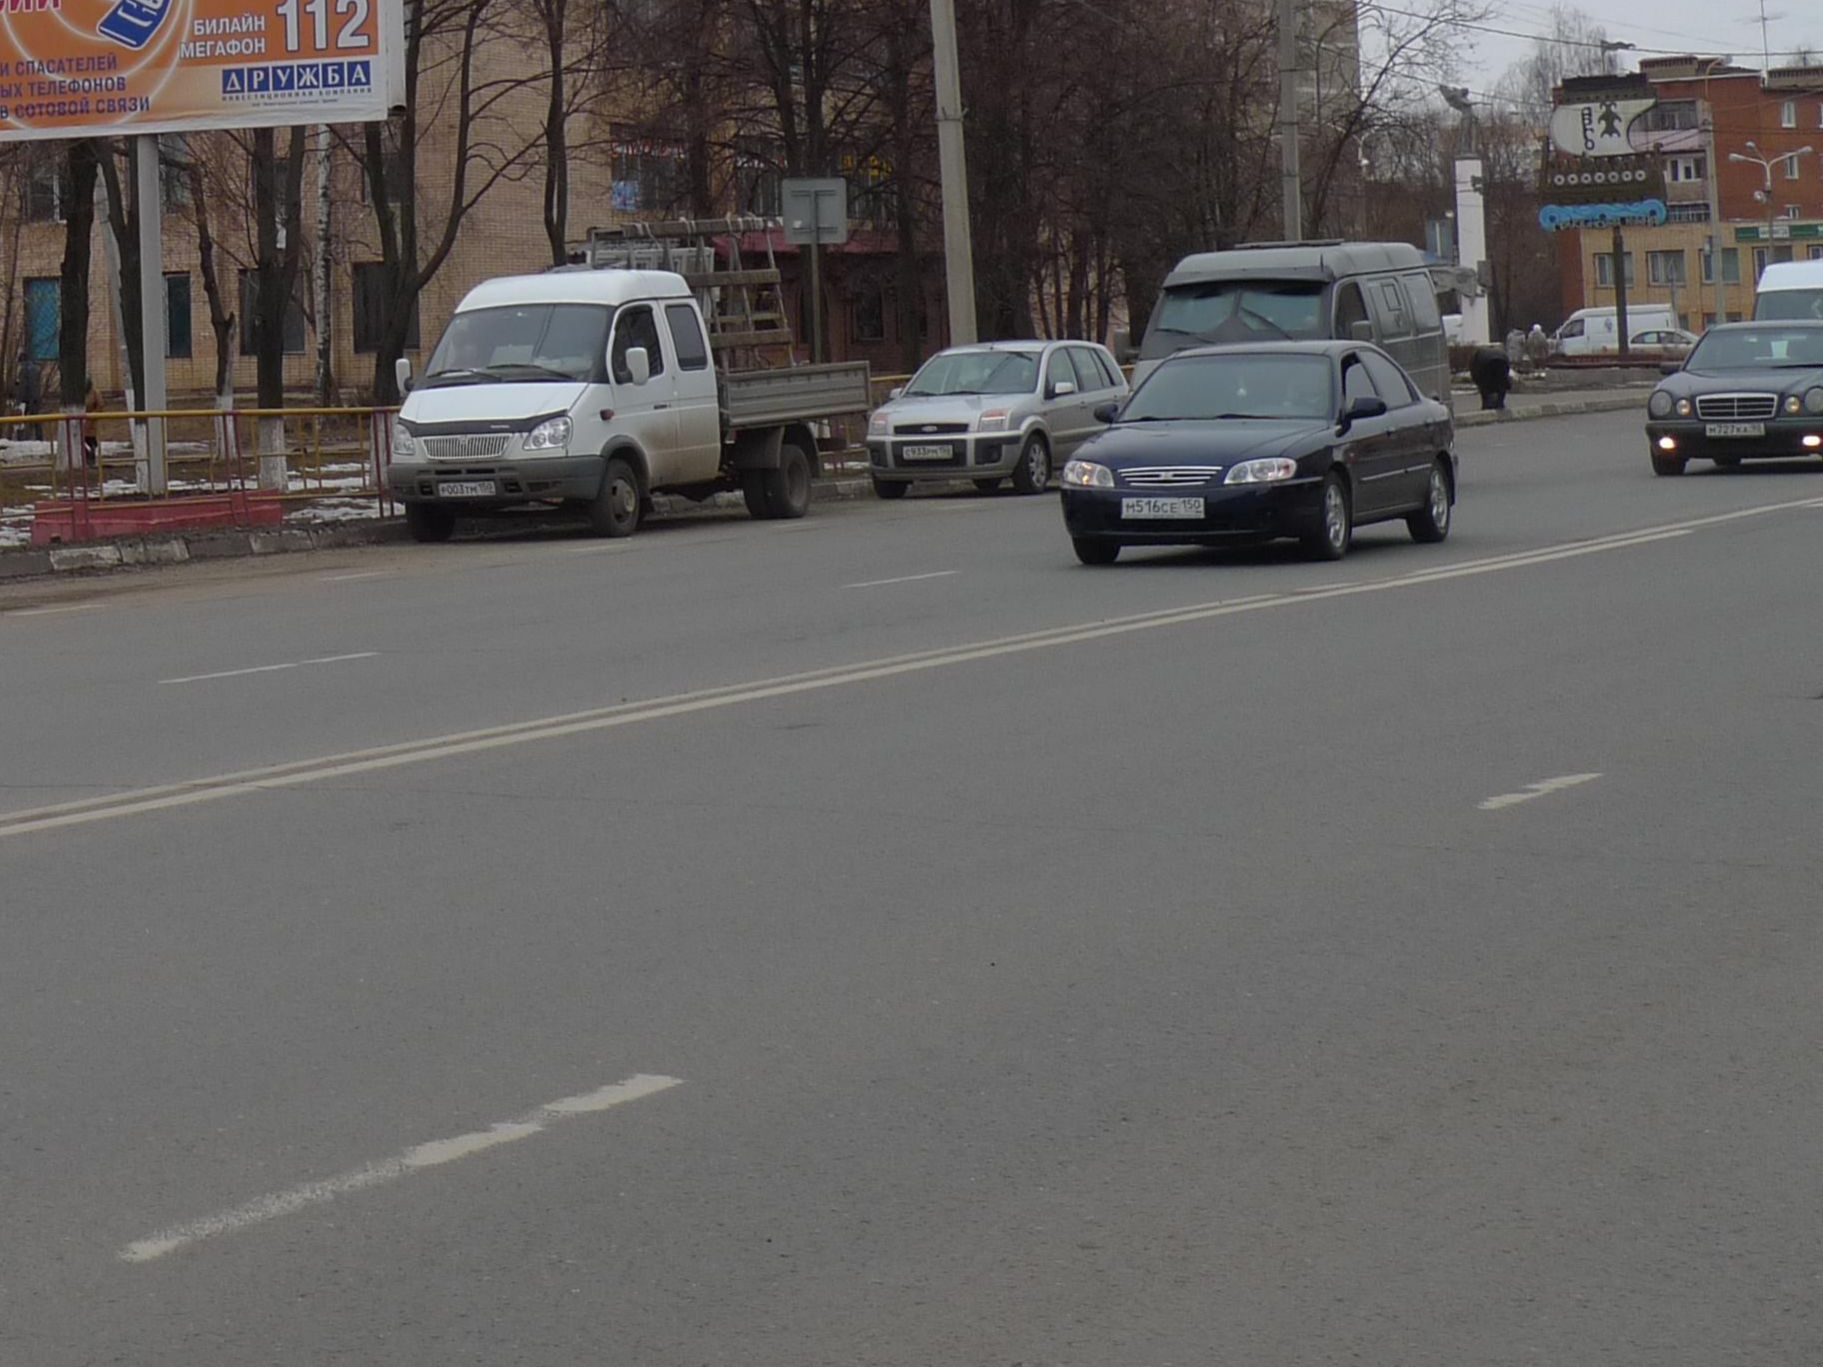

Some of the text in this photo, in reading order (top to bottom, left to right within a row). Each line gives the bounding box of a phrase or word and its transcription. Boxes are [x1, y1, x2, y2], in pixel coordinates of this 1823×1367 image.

[194, 13, 266, 36] БИЛАЙН
[179, 38, 266, 59] МЕГАФОН
[0, 62, 10, 77] И
[15, 52, 118, 76] СПАСАТЕЛЕЙ
[28, 76, 126, 97] ТЕЛЕФОНОВ
[223, 61, 370, 93] ДРУЖБА
[14, 98, 90, 119] СОТОВОЙ
[95, 96, 150, 114] СВЯЗИ
[1125, 499, 1201, 513] М516СЕ 150
